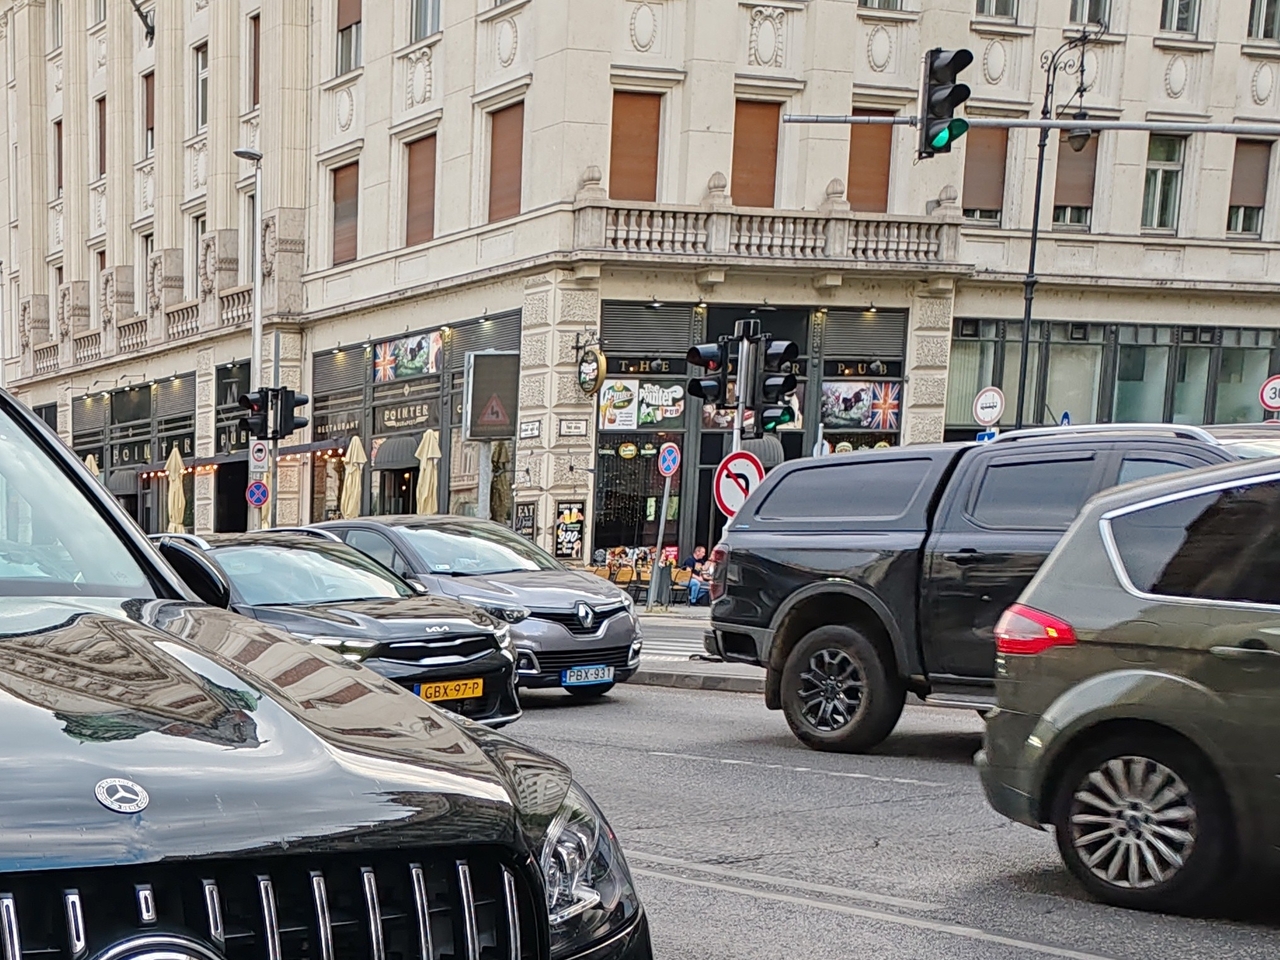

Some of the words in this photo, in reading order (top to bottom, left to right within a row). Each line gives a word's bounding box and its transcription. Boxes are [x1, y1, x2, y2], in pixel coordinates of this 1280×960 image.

[619, 361, 670, 372] THE
[837, 363, 887, 375] PUB
[643, 384, 661, 394] The
[1269, 387, 1280, 400] 3
[639, 387, 677, 406] Pointer
[384, 404, 429, 421] POINTER
[664, 407, 680, 416] PUB
[317, 420, 359, 434] RESTAURANT
[221, 430, 246, 447] PUB
[568, 667, 611, 682] PBX-931
[424, 681, 479, 699] GBX-97-P
